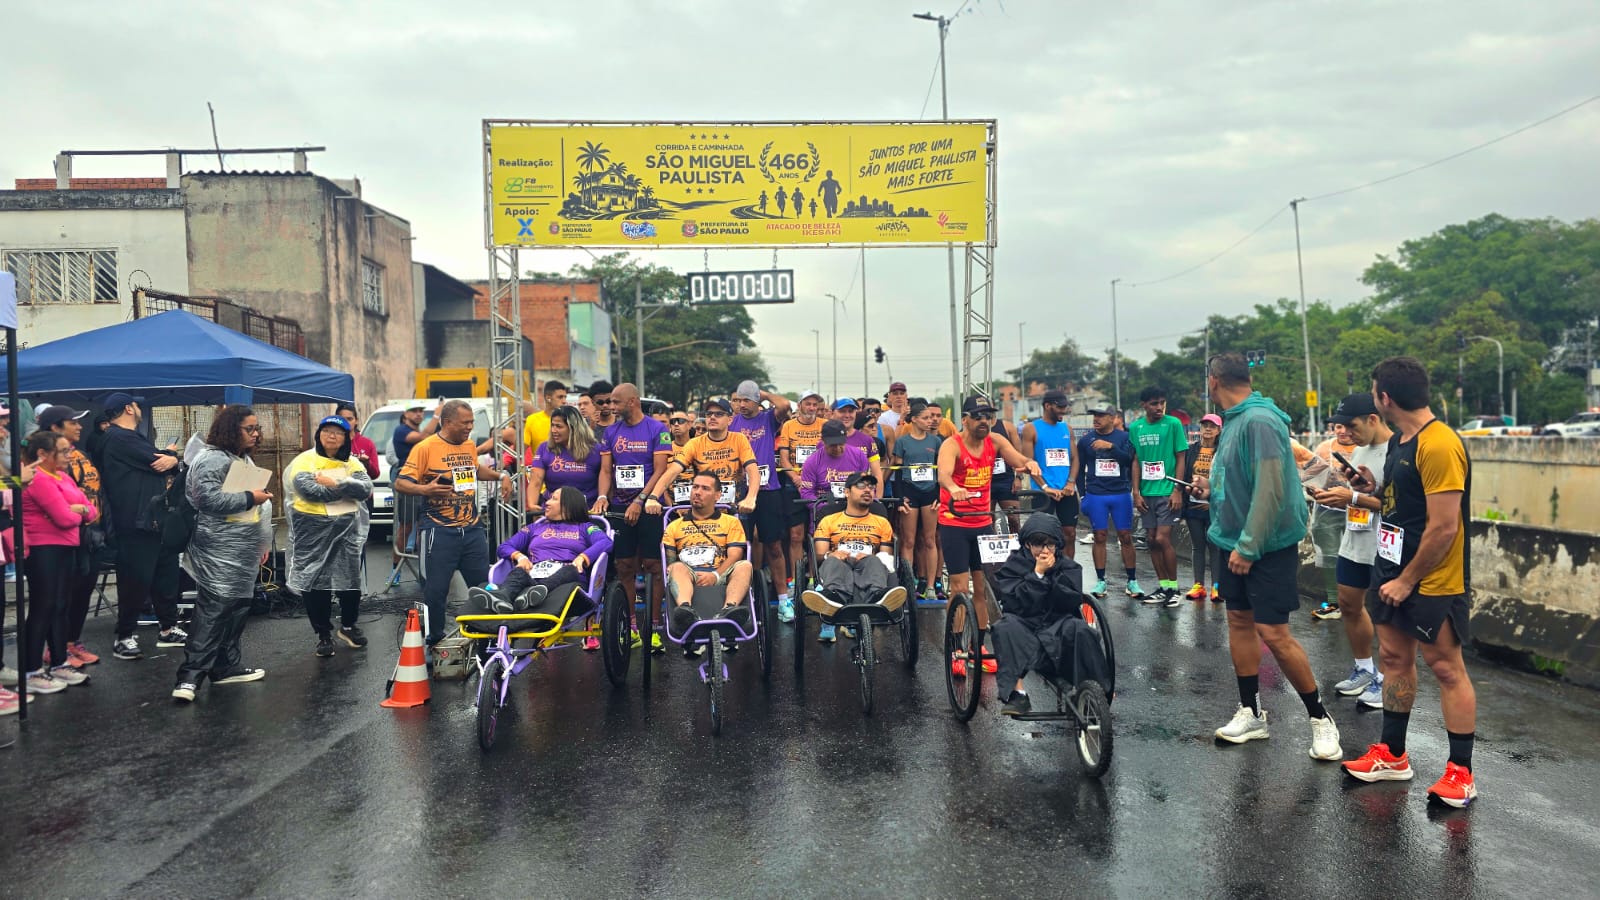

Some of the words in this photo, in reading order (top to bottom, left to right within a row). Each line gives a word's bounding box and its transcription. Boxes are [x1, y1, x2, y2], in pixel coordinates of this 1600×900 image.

[869, 145, 905, 161] JUNTOS
[908, 141, 928, 155] POR
[931, 138, 953, 151] UMA
[499, 158, 553, 168] Realização:
[645, 152, 684, 169] SÃO
[689, 154, 755, 169] MIGUEL
[769, 153, 809, 170] 466
[858, 162, 881, 178] SÃO
[884, 157, 926, 174] MIGUEL
[929, 149, 977, 168] PAULISTA
[659, 171, 745, 184] PAULISTA
[887, 173, 915, 189] MAIS
[919, 168, 955, 184] FORTE
[505, 206, 539, 218] Apoio:
[691, 273, 791, 302] 00:00:00
[620, 470, 636, 479] 583
[988, 540, 1010, 551] 047
